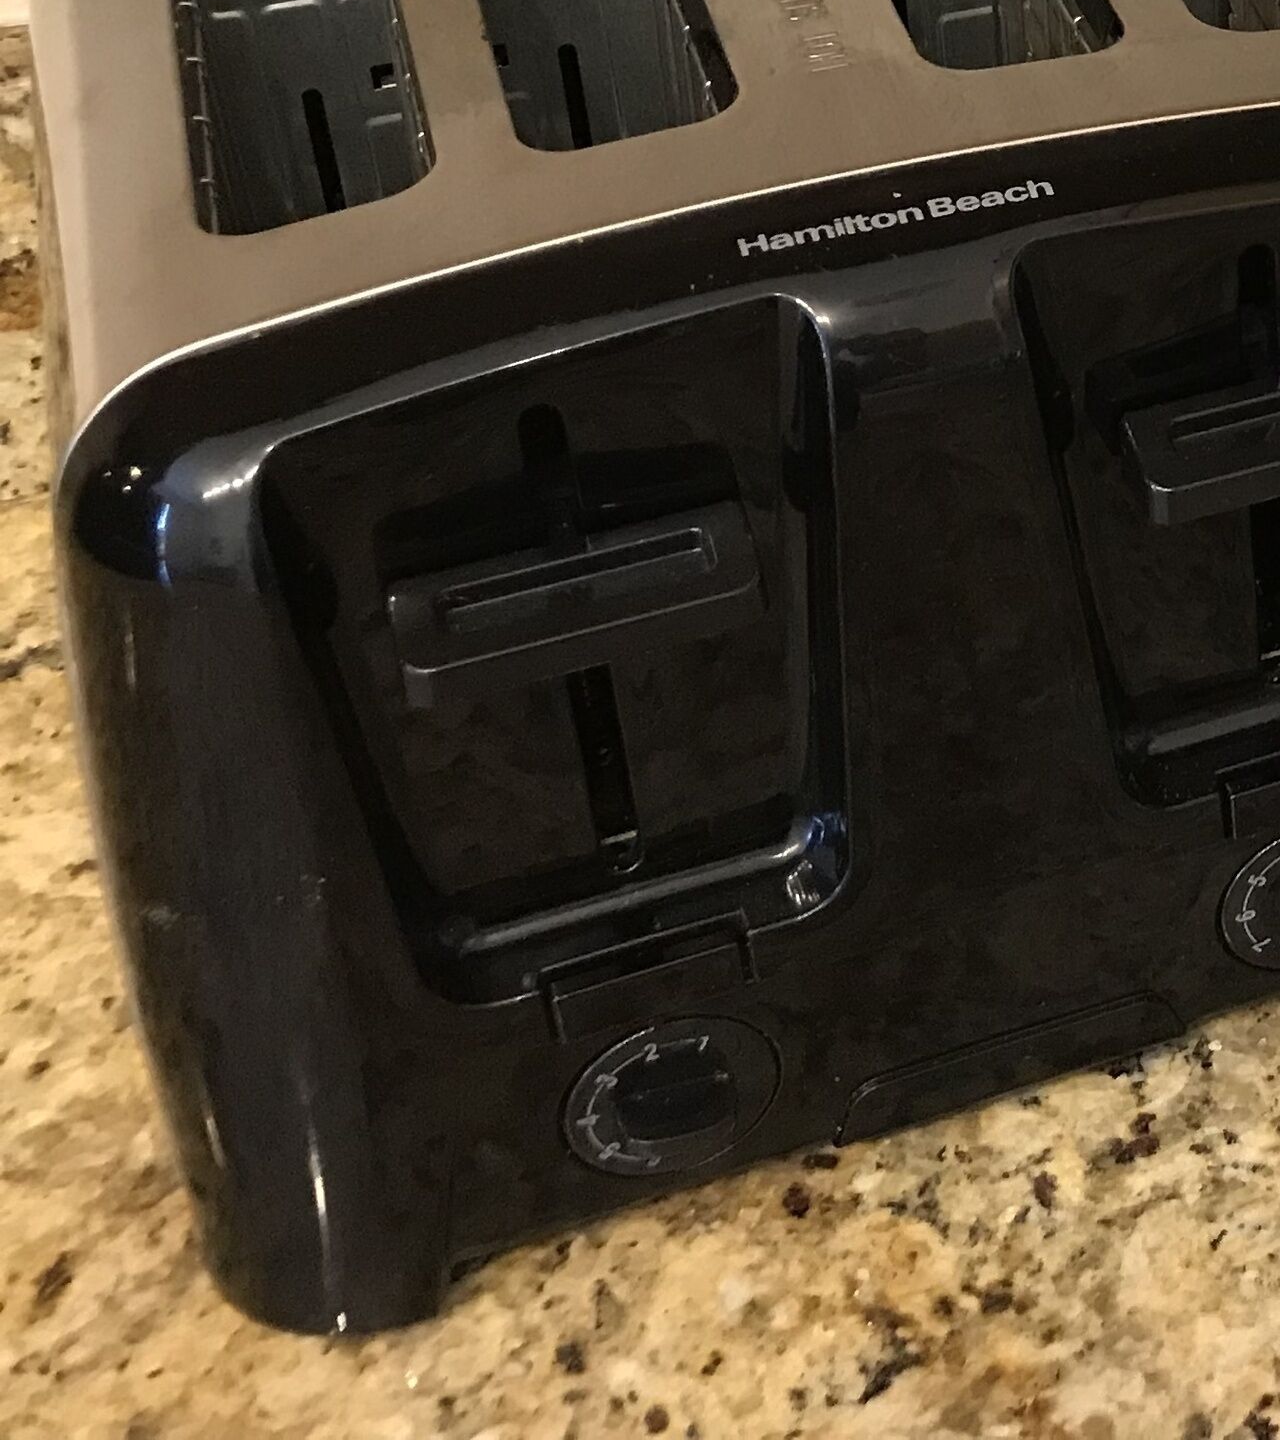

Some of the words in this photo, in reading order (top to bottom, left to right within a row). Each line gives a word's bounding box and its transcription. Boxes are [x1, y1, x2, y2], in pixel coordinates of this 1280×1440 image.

[737, 206, 925, 257] Hamilton
[926, 180, 1055, 218] Beach
[643, 1043, 659, 1062] 2
